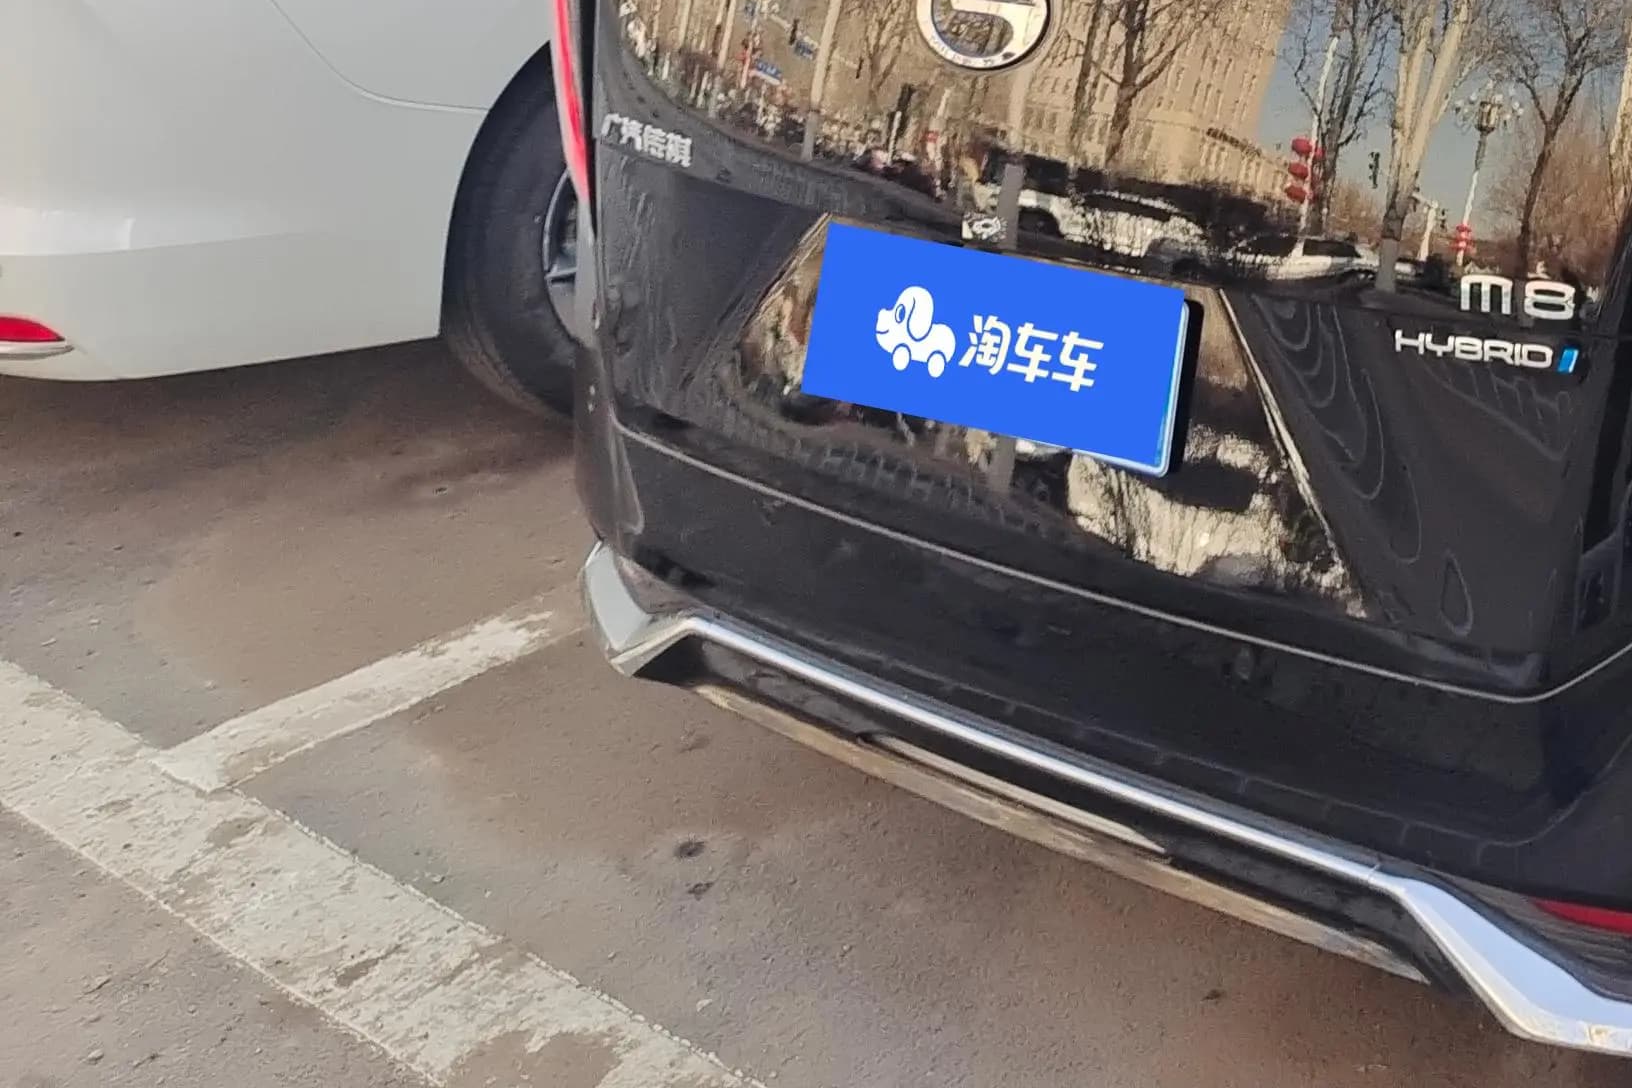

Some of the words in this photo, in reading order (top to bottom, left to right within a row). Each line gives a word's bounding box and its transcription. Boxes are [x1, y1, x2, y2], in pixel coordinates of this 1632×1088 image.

[601, 113, 692, 168] 广汽传祺
[1460, 274, 1576, 320] M8
[1395, 329, 1553, 369] HYBRID
